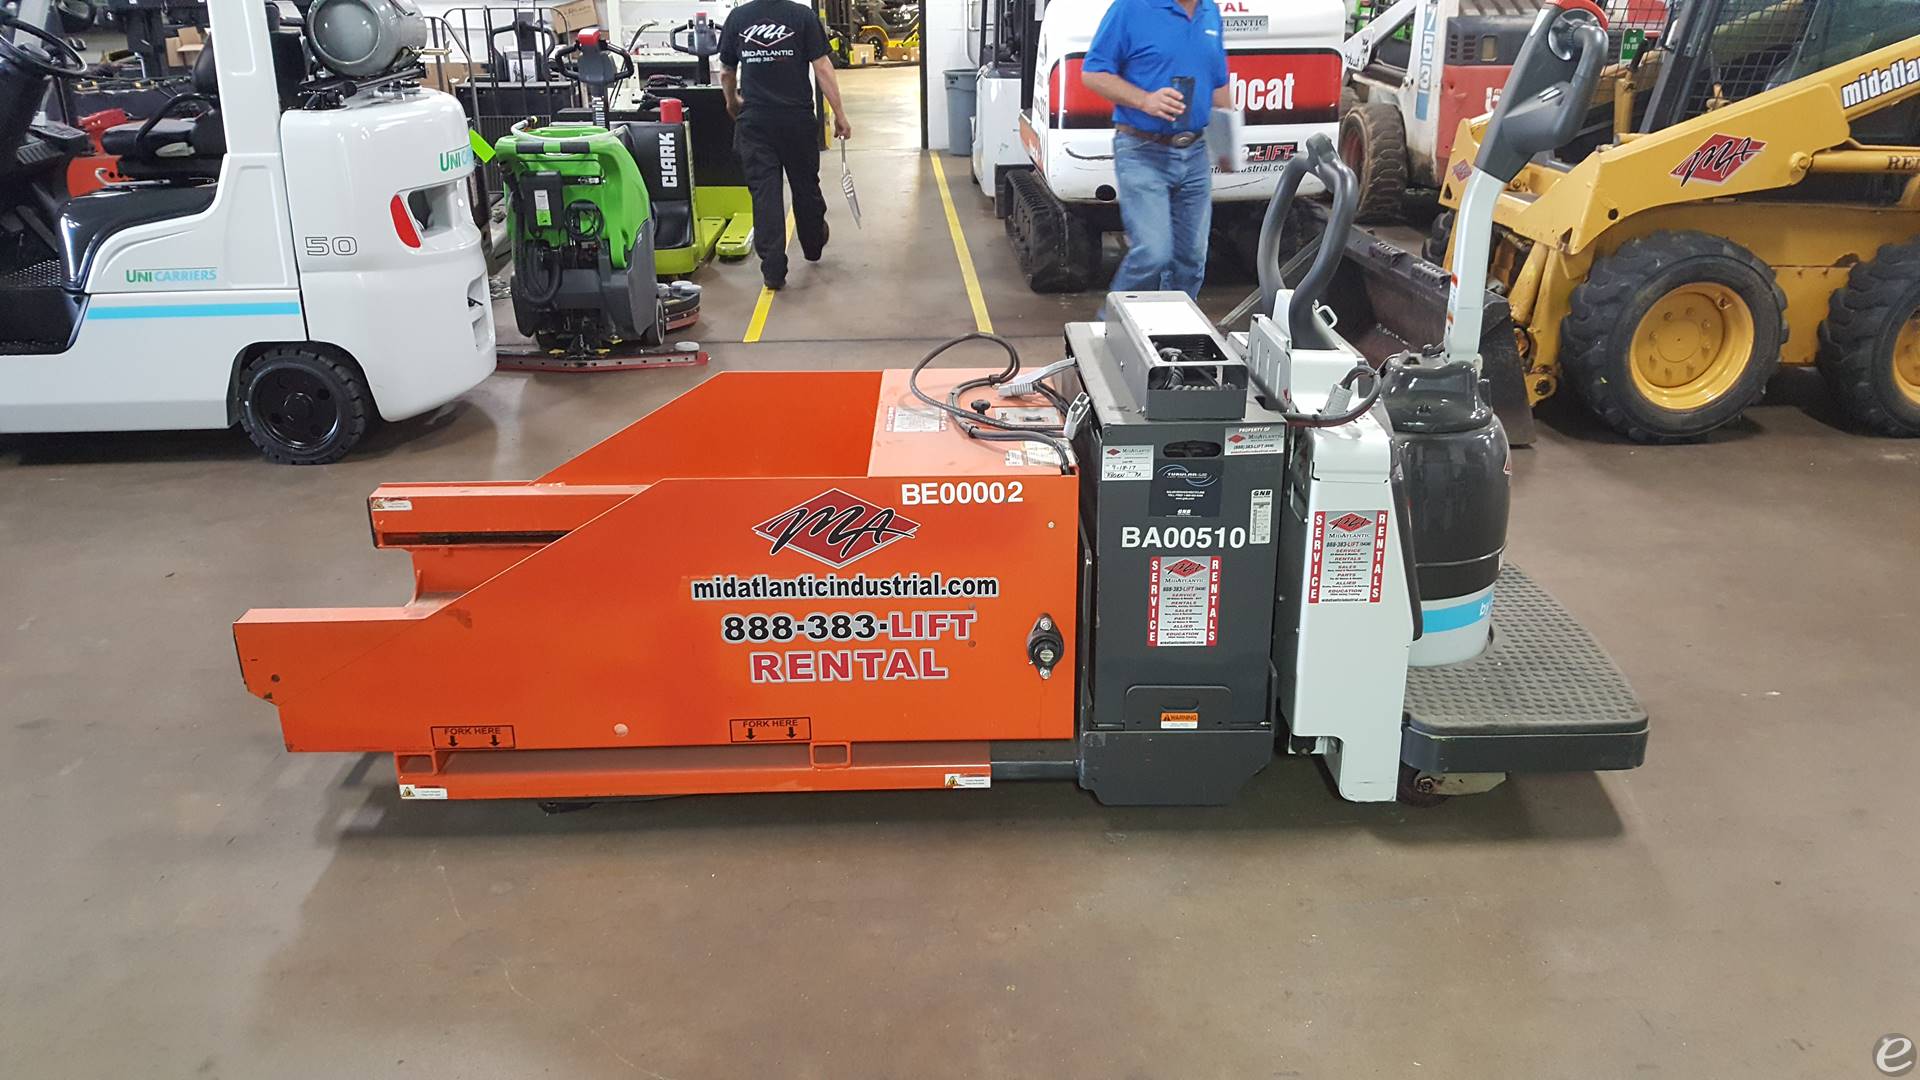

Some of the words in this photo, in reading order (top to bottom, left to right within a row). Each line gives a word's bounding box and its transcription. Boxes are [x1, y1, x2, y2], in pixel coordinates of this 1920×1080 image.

[1841, 56, 1920, 109] midatla
[658, 132, 678, 187] CLARK
[305, 236, 358, 256] 50
[901, 481, 1024, 505] BE00002
[766, 505, 915, 558] MA
[1122, 526, 1246, 549] BA00510
[1311, 515, 1323, 598] SERVICE
[1372, 514, 1386, 598] RENTALS
[693, 574, 997, 599] midatlanticindustrial.com
[1149, 561, 1159, 641] SERVICE
[1208, 560, 1219, 640] RENTALS
[752, 651, 947, 681] RENTAL
[444, 727, 472, 735] FORK
[474, 727, 501, 735] HERE
[743, 720, 770, 728] FORK
[772, 719, 799, 727] HERE
